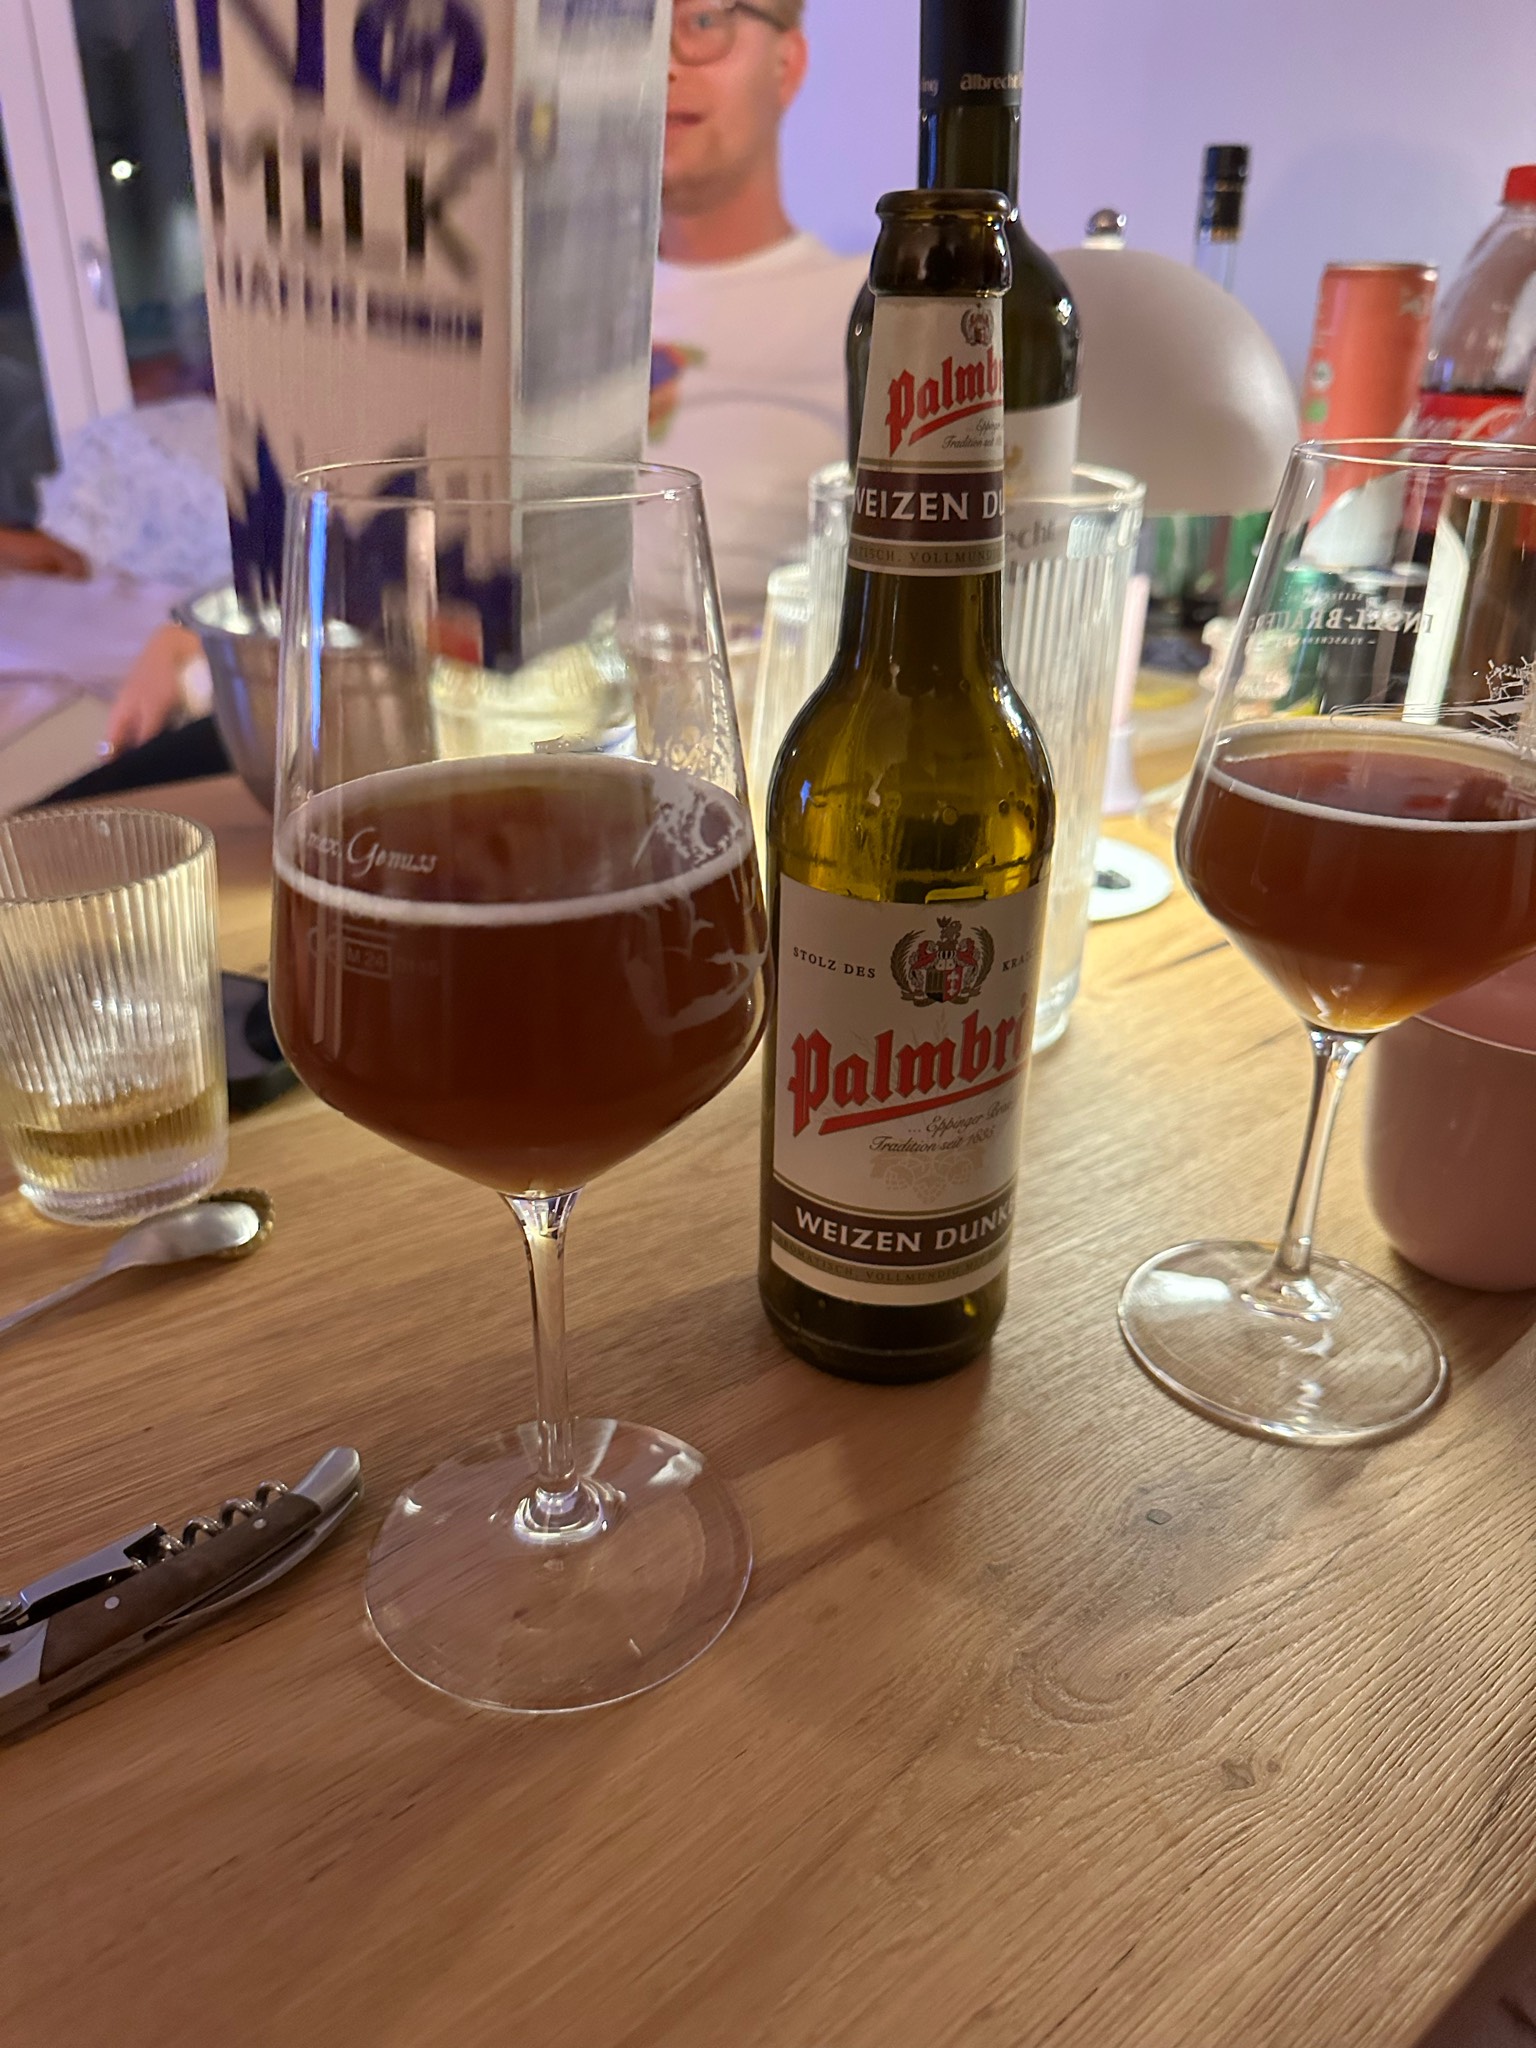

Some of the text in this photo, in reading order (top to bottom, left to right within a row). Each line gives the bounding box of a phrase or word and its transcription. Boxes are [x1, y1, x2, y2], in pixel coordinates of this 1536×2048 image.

[793, 946, 837, 972] STOLZ
[843, 965, 876, 979] DES
[926, 1105, 984, 1138] Eppinger
[869, 1135, 937, 1152] Tradition
[939, 1136, 963, 1150] seit
[796, 1205, 922, 1253] WEIZEN
